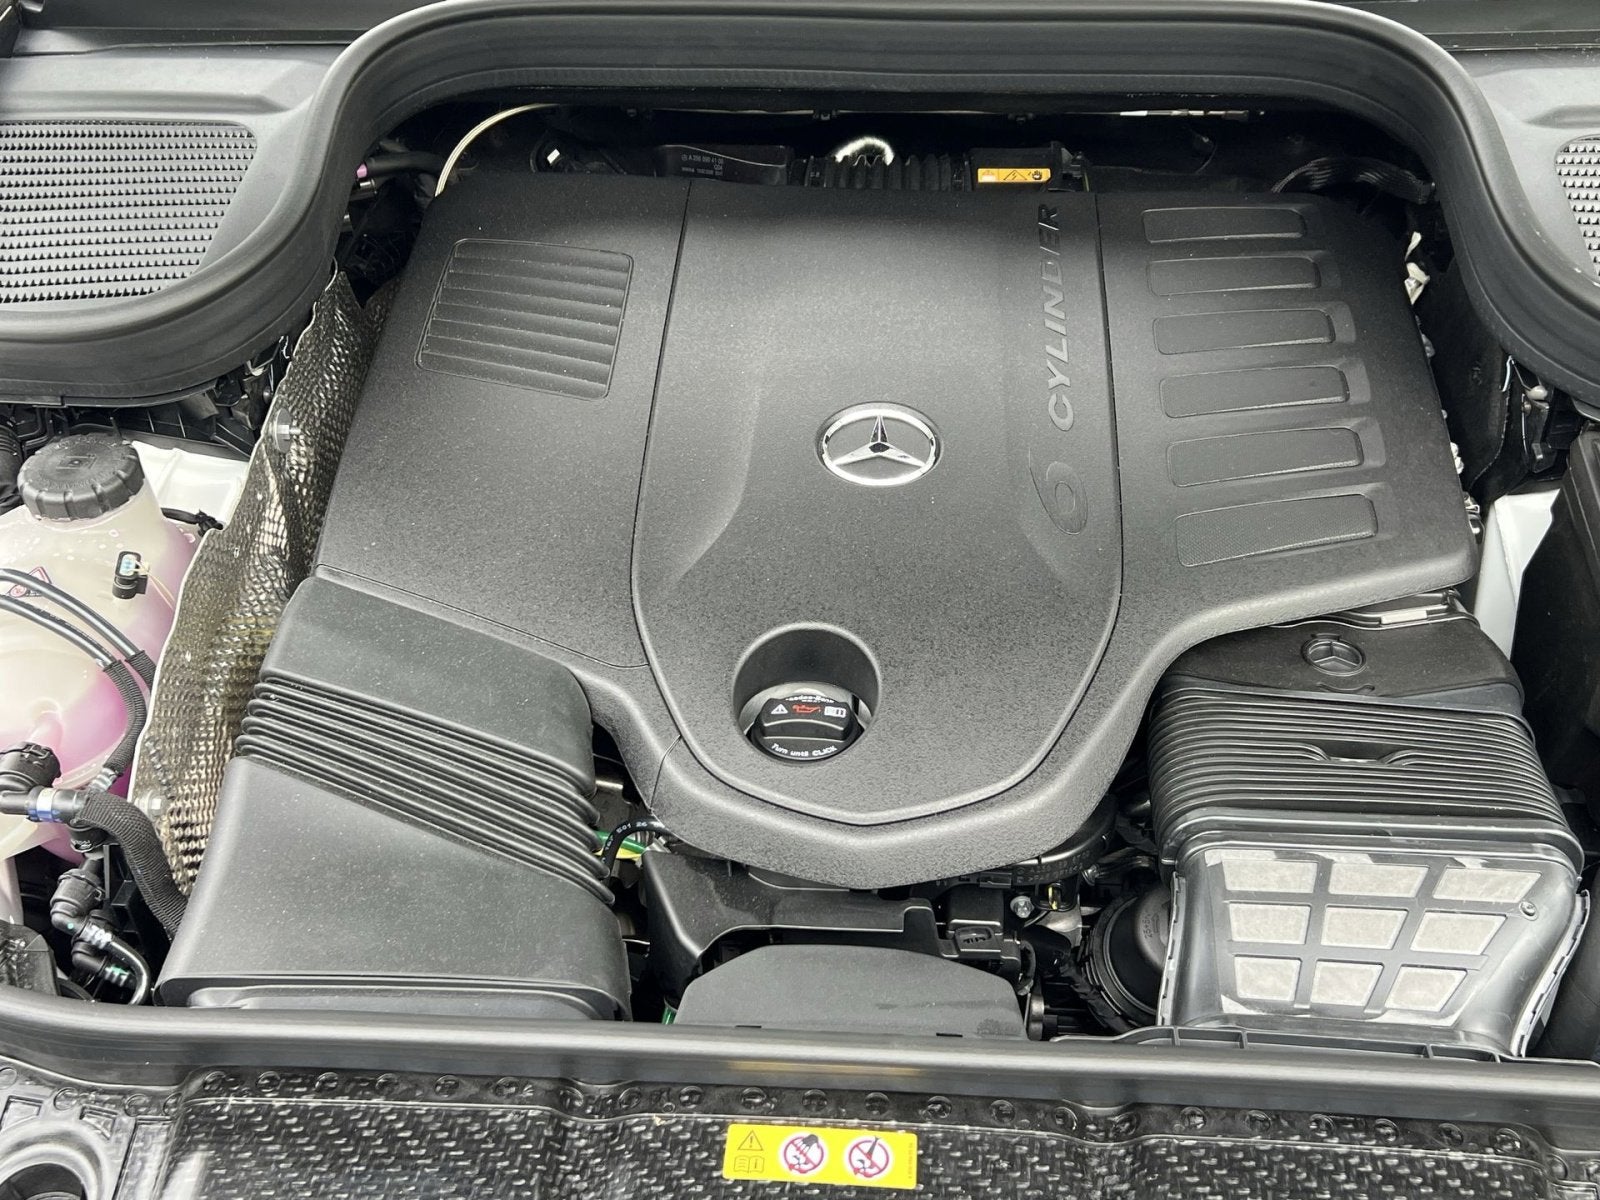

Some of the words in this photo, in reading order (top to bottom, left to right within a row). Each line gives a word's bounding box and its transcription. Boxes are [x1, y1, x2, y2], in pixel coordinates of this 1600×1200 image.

[1037, 203, 1075, 432] CYLINDER
[771, 743, 789, 755] Turn
[812, 745, 838, 757] CLICK
